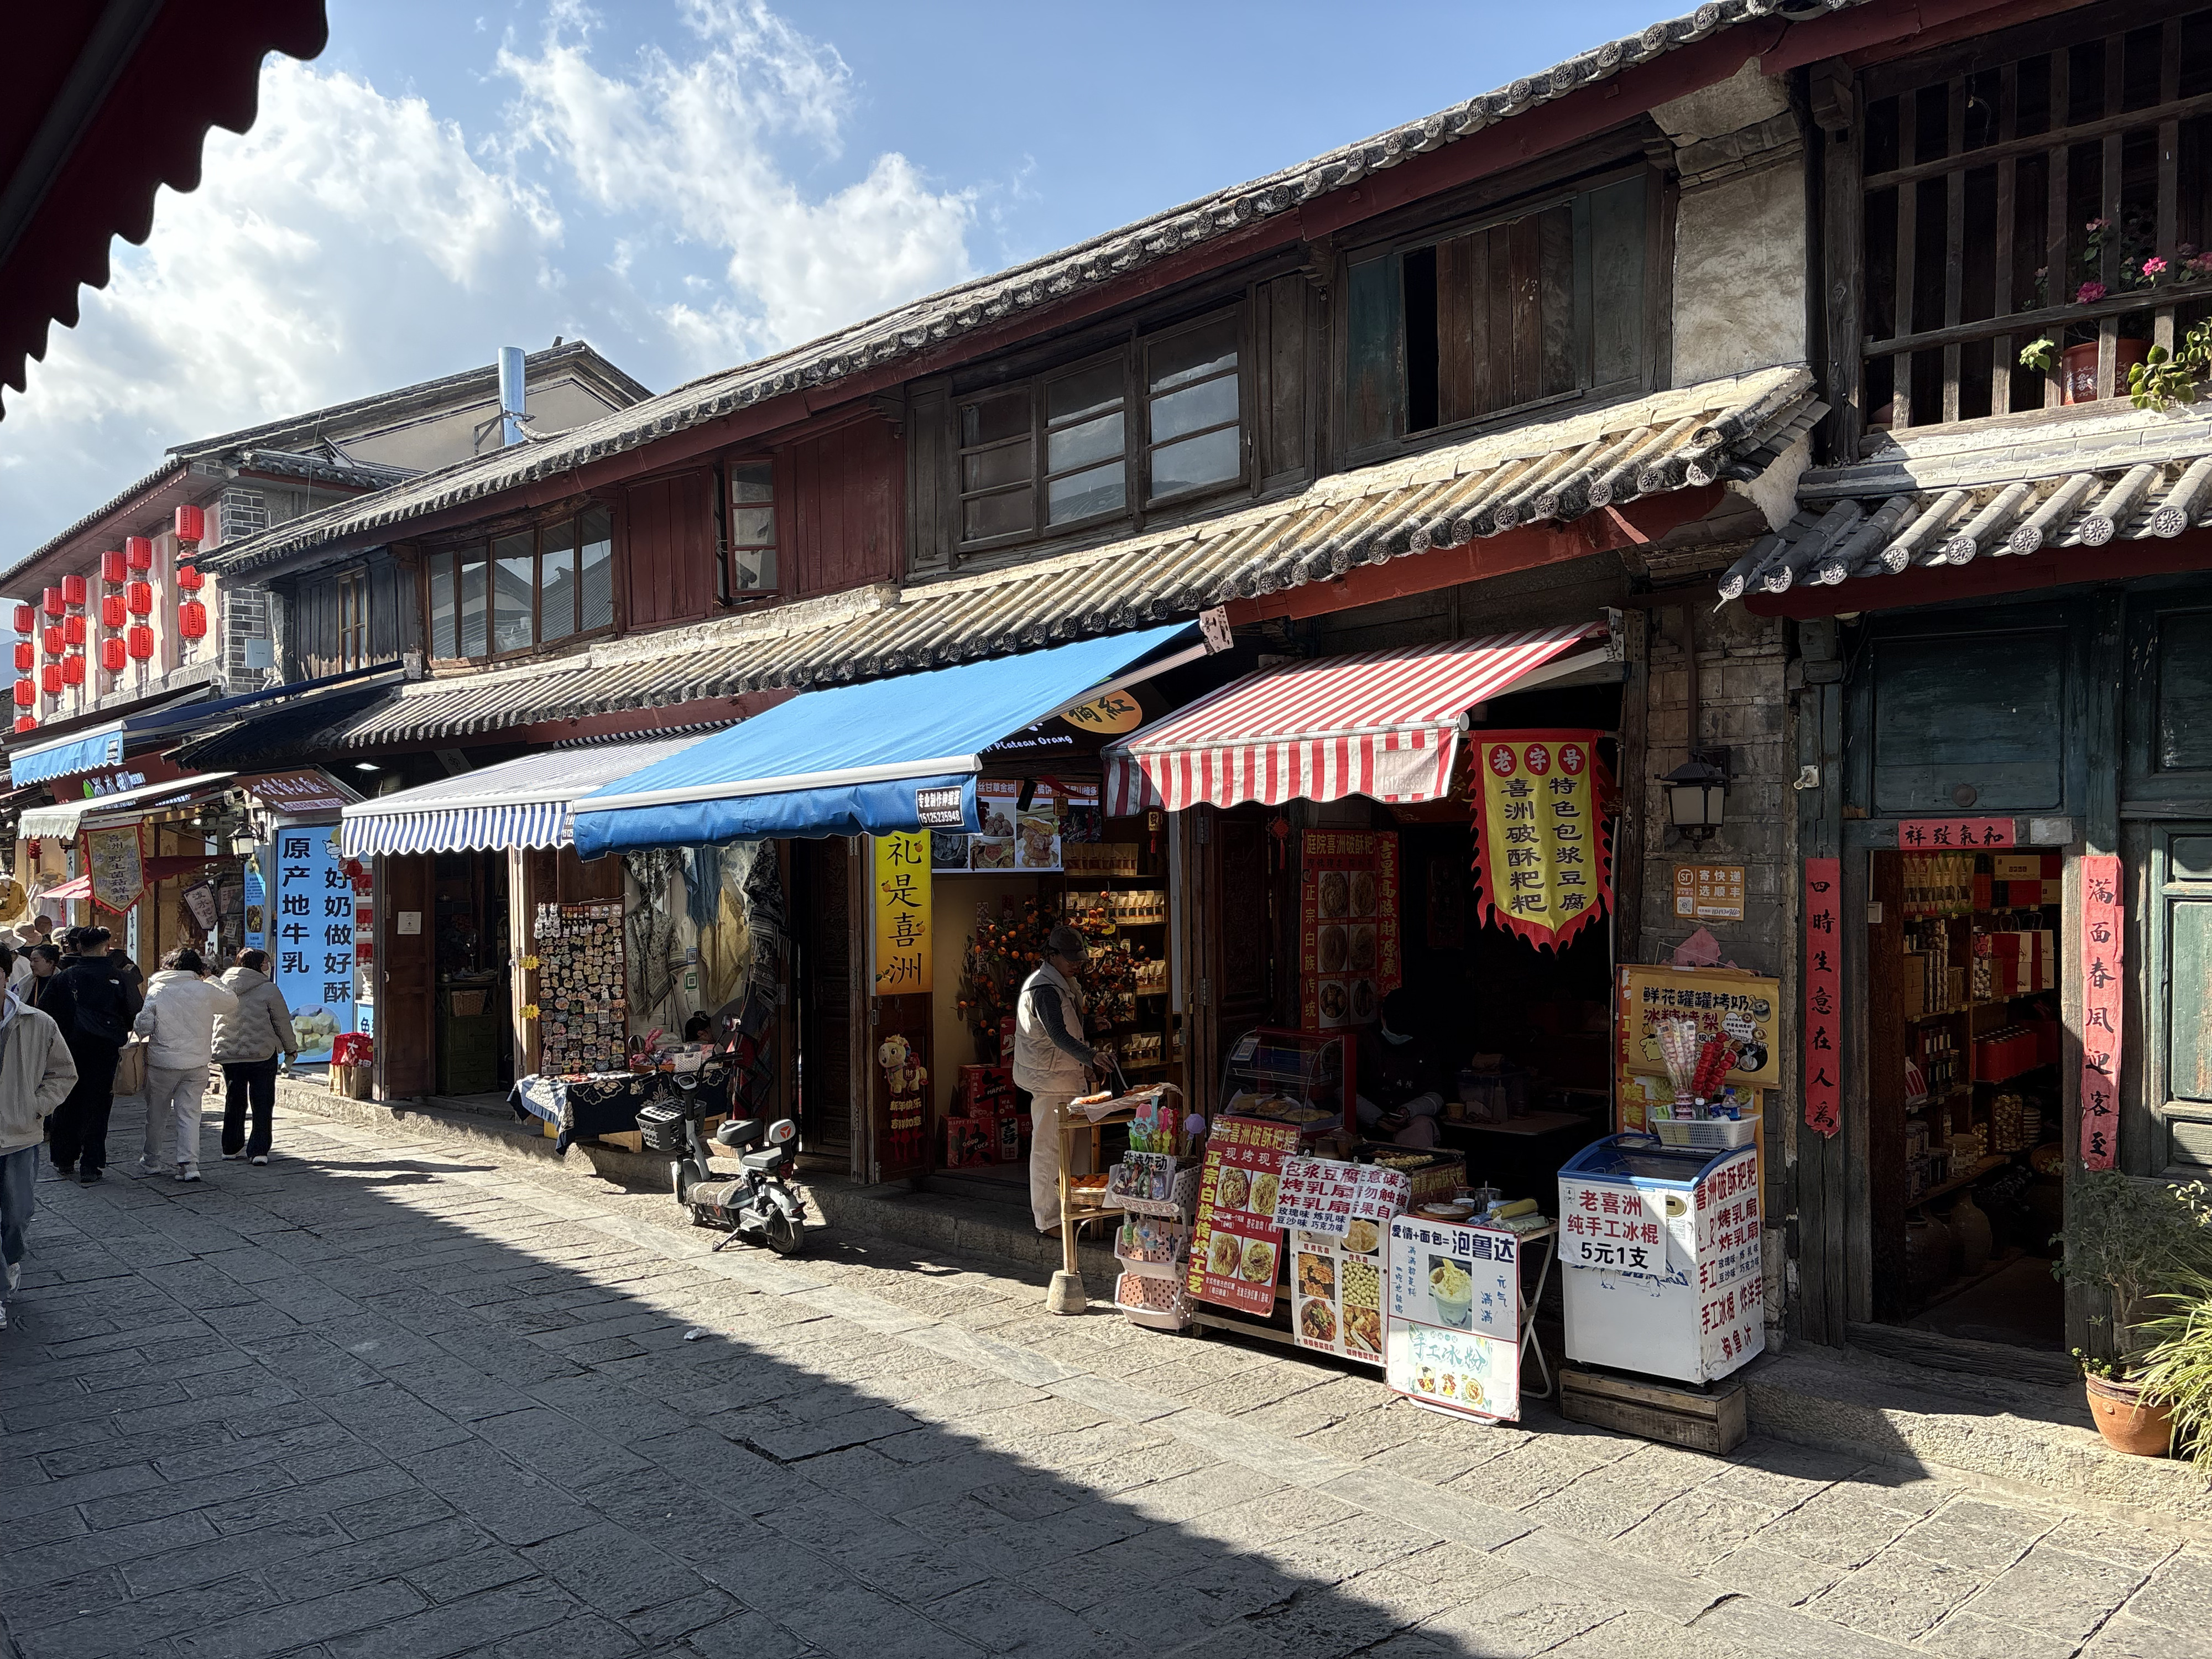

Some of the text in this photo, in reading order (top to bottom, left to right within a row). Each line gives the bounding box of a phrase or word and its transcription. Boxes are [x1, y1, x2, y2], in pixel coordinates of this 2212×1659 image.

[1493, 747, 1584, 773] 老字号
[918, 790, 961, 808] 专业制作伸缩篷
[919, 810, 961, 823] 15125235948
[1306, 833, 1374, 855] 庭院喜洲破酥粑
[1501, 778, 1548, 915] 喜洲破酥粑粑
[1549, 777, 1587, 911] 特色包浆豆腐
[1699, 870, 1741, 882] 寄快递
[1699, 885, 1740, 897] 选顺丰
[282, 837, 311, 974] 原产地牛乳
[886, 836, 923, 986] 礼是喜洲
[324, 867, 352, 1004] 好奶做好酥
[1305, 884, 1316, 1030] 正宗白族传统
[1643, 986, 1749, 1011] 鲜花罐罐烤奶
[987, 1084, 1006, 1095] HAPPY
[890, 1098, 922, 1111] 新年快乐
[891, 1116, 922, 1130] 吉祥如意
[962, 1138, 979, 1147] GOOD
[1224, 1147, 1286, 1167] 现烤现卖
[1286, 1160, 1361, 1185] 包浆豆腐
[1696, 1157, 1757, 1211] 喜洲破酥粑粑
[1281, 1177, 1355, 1199] 烤乳扇
[1278, 1193, 1351, 1214] 炸乳扇
[1278, 1207, 1347, 1224] 玫瑰味 炼乳味
[1352, 1201, 1400, 1220] 果自
[1579, 1190, 1642, 1218] 老喜洲
[1718, 1198, 1757, 1231] 烤乳扇
[1188, 1150, 1222, 1293] 正宗白族传统工艺
[1275, 1215, 1344, 1233] 豆沙味 巧克力味
[1567, 1213, 1659, 1245] 纯手工冰棍
[1391, 1224, 1515, 1264] 爱情+面包=泡鲁达
[1719, 1220, 1759, 1253] 炸乳扇
[1348, 1253, 1368, 1264] 炸乳扇
[1580, 1241, 1649, 1270] 5元1支
[1718, 1254, 1736, 1269] 玫瑰味
[1719, 1256, 1760, 1284] 豆沙味 巧克力味
[1497, 1275, 1507, 1307] 元气
[1480, 1291, 1493, 1324] 满满
[1702, 1275, 1762, 1335] 手工冰棍 炸洋芋
[1413, 1332, 1486, 1372] 手工冰粉
